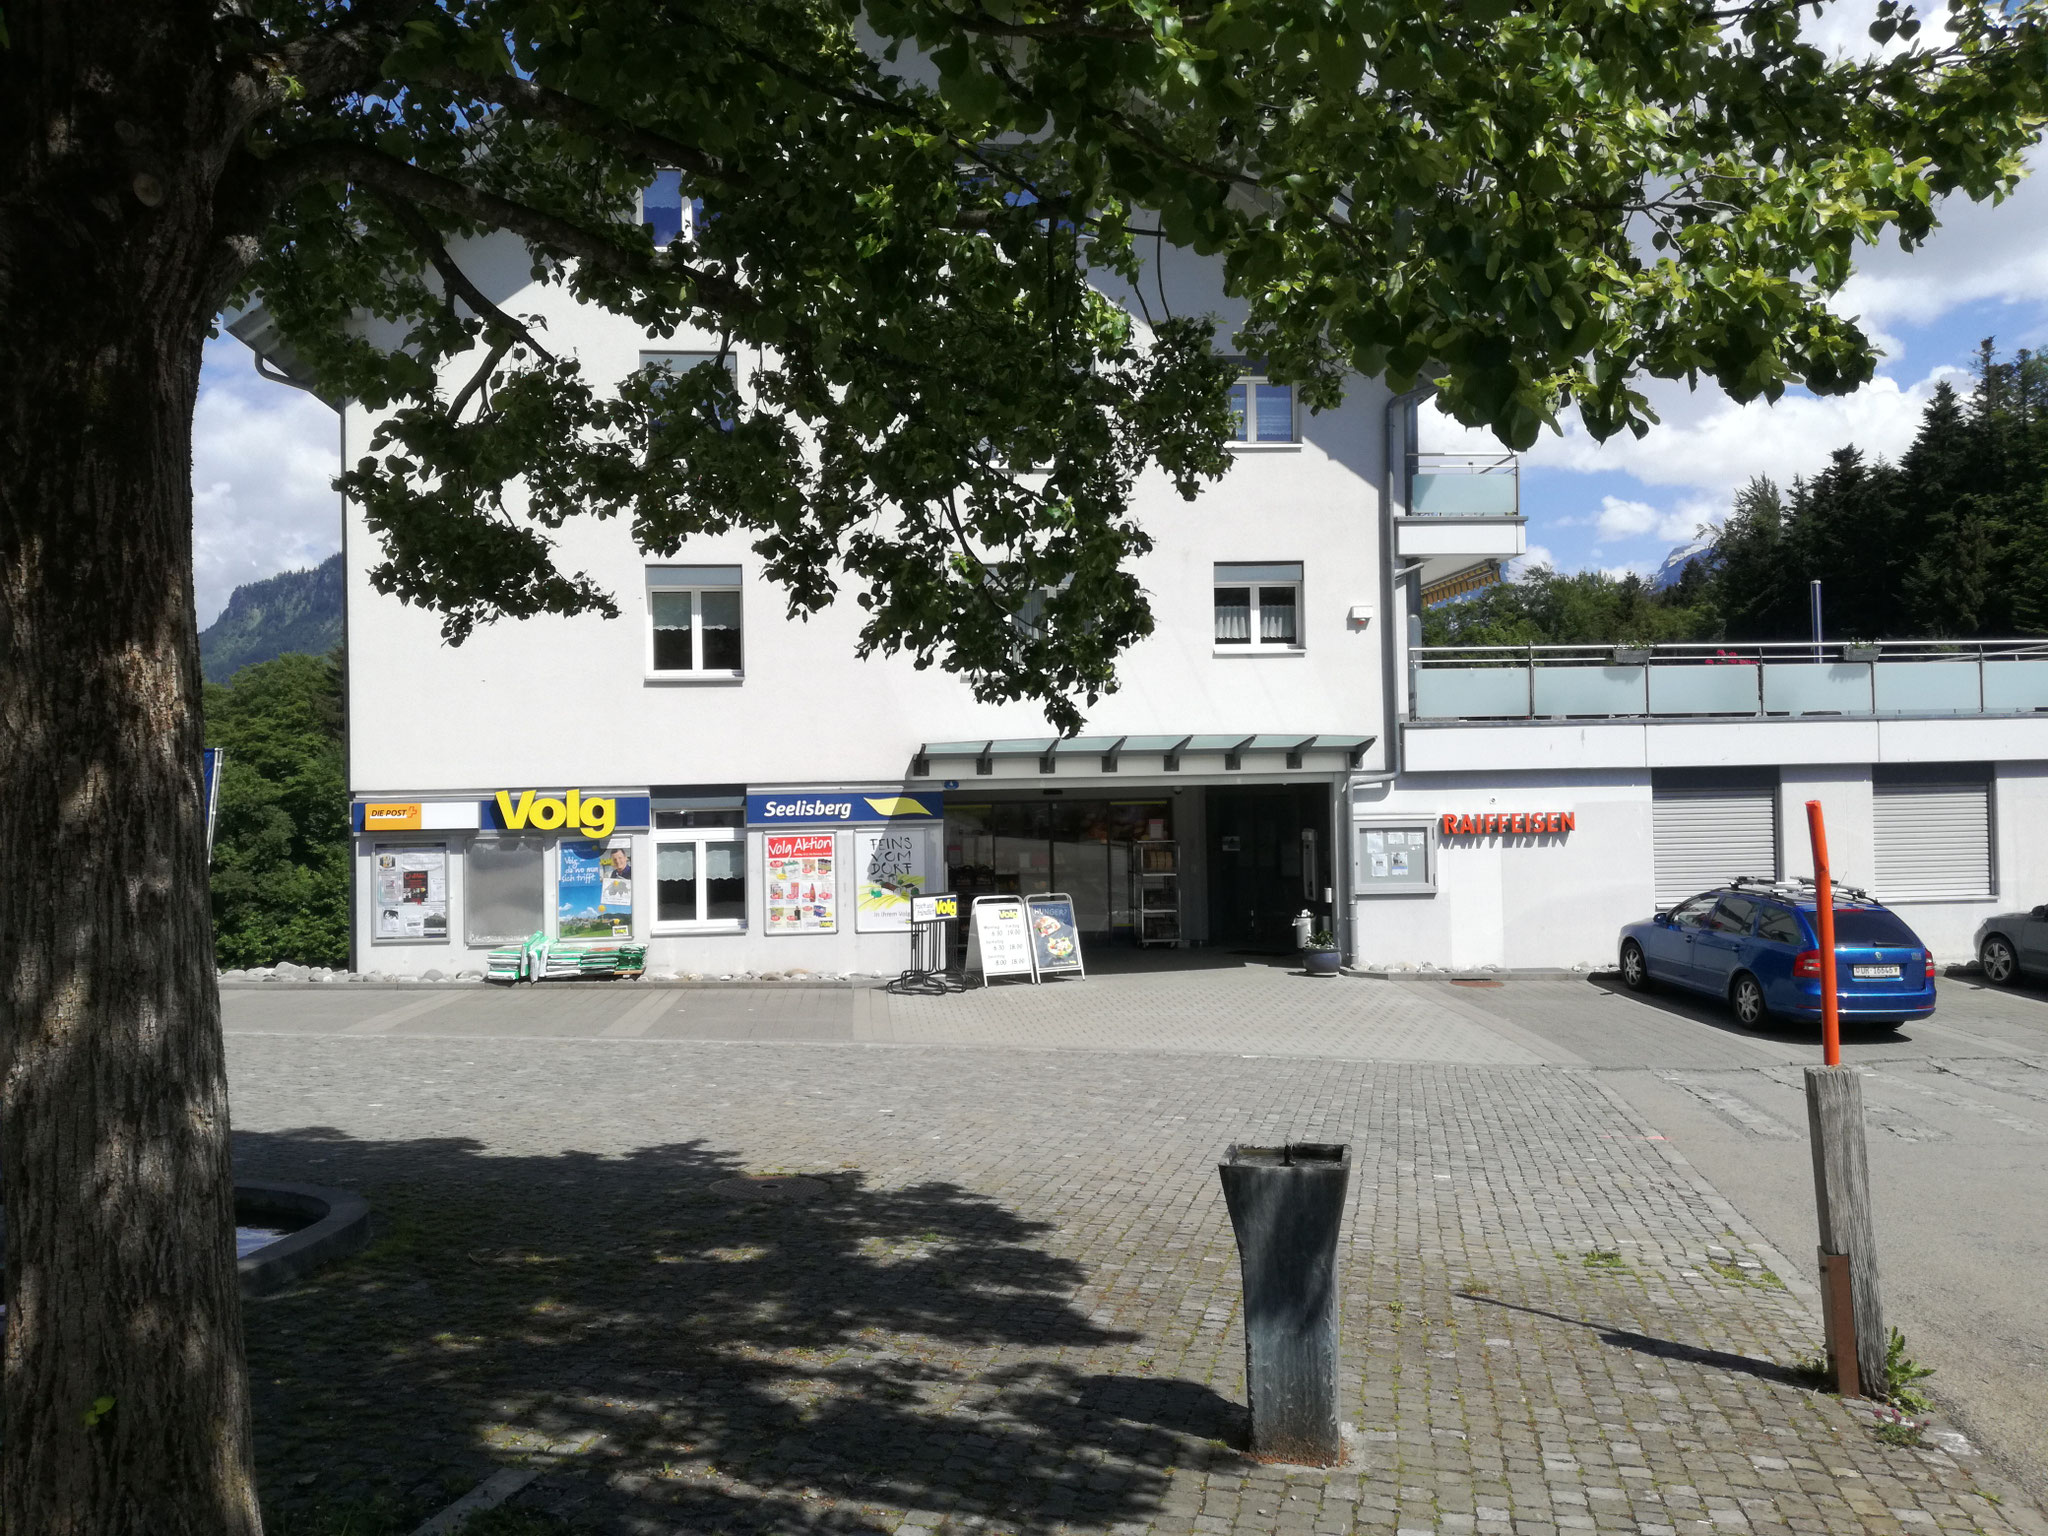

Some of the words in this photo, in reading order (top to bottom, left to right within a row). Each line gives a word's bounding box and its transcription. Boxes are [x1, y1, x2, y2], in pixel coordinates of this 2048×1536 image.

[371, 809, 385, 817] DIE
[386, 809, 407, 817] POST
[495, 789, 616, 839] Volg
[764, 800, 852, 819] Seelisberg
[1442, 811, 1576, 835] RAIFFEISEN
[768, 840, 793, 859] Volg
[793, 836, 832, 853] Aktion
[871, 850, 911, 862] VOM
[871, 862, 912, 875] DORF
[935, 898, 957, 916] Volg
